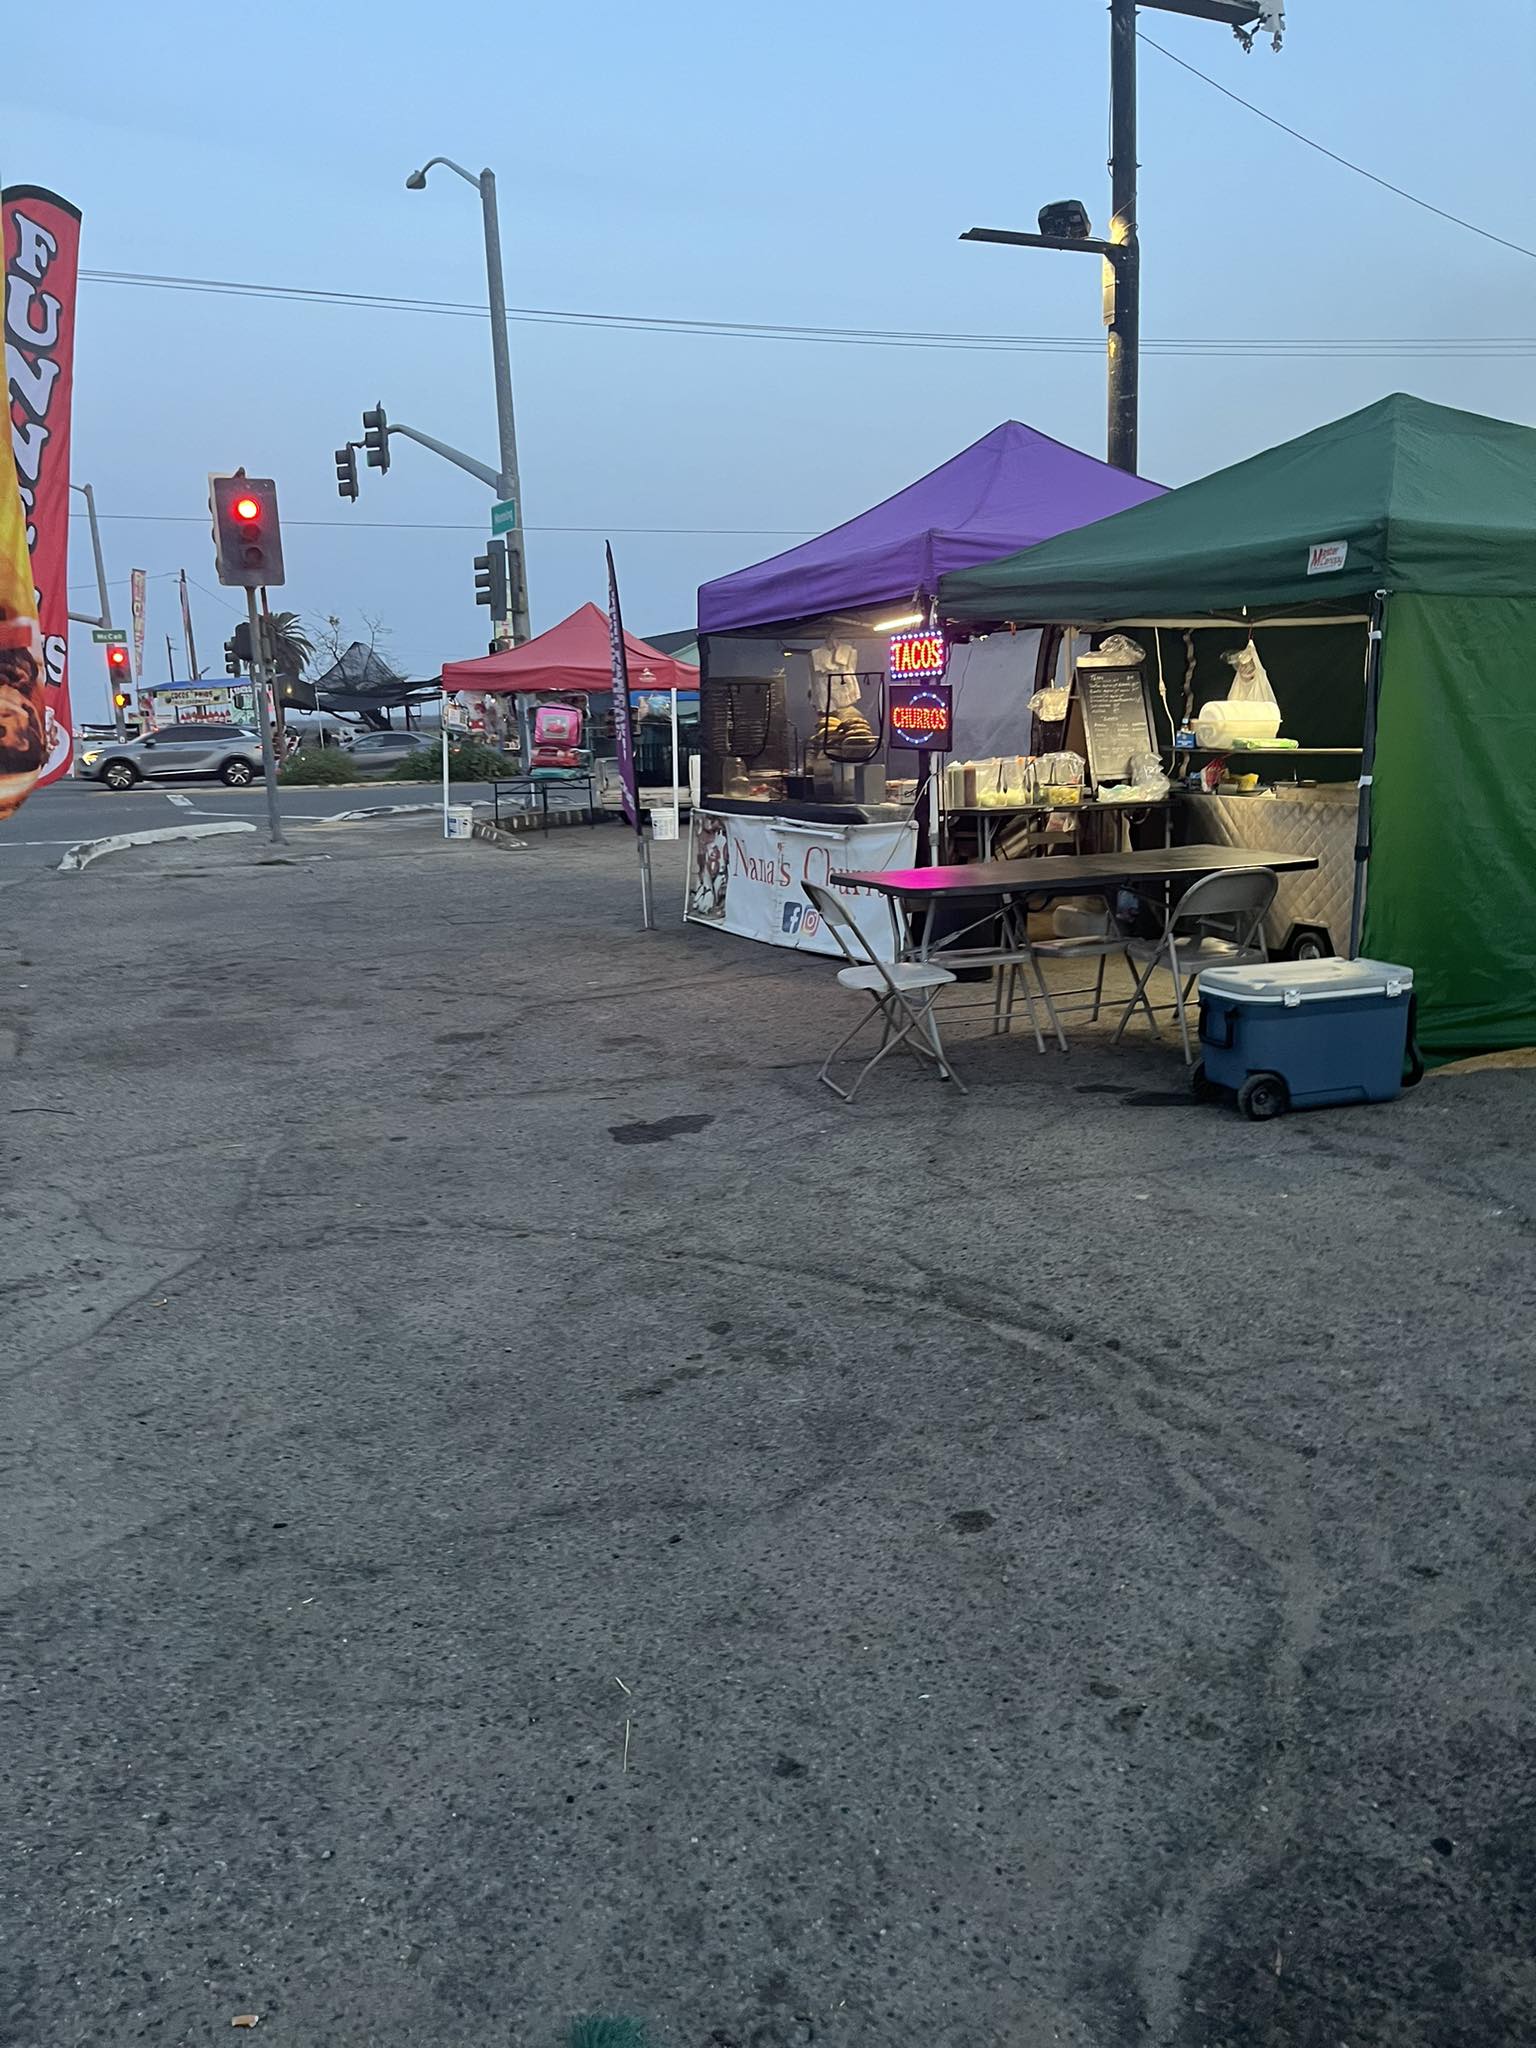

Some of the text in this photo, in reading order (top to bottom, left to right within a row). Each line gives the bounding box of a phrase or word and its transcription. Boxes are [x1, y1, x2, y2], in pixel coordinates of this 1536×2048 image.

[5, 213, 61, 546] FUNN
[894, 639, 941, 671] TACOS
[893, 707, 947, 730] CHURROS
[733, 837, 791, 887] Nana's
